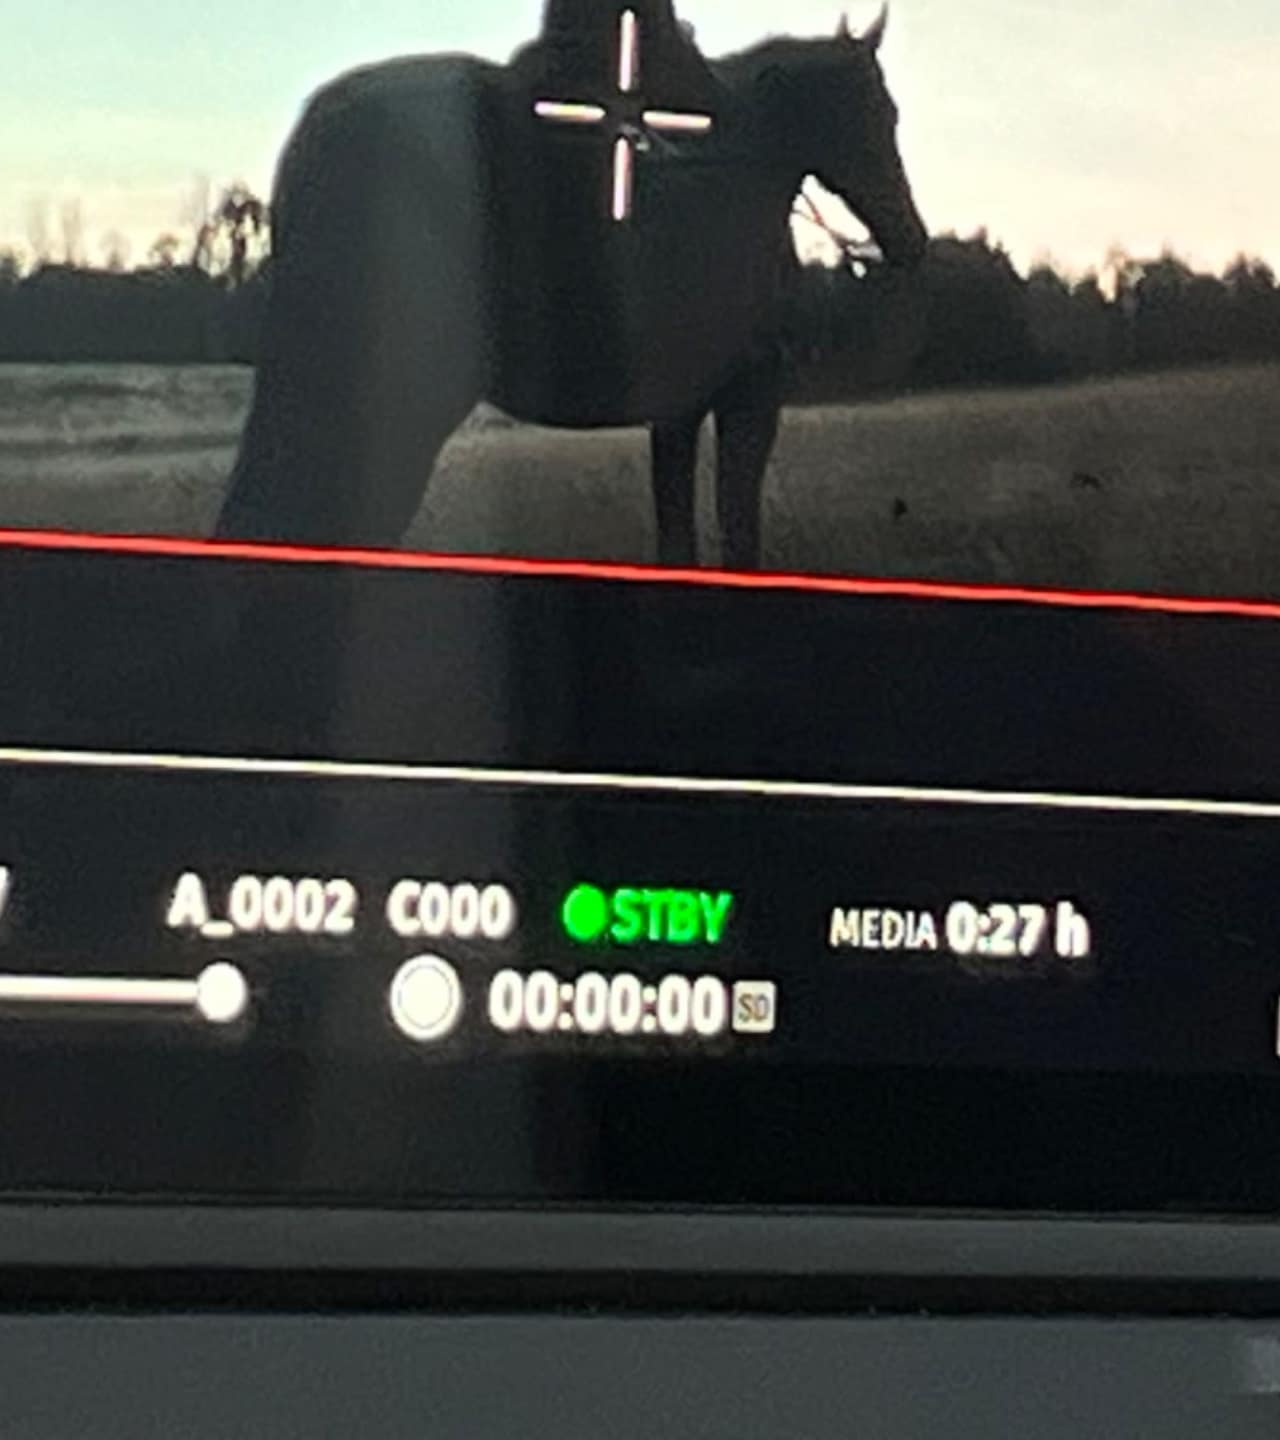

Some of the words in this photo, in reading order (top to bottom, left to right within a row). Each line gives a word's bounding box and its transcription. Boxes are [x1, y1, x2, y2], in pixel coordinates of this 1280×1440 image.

[166, 873, 356, 939] A_0002
[387, 878, 516, 940] C000
[609, 887, 732, 943] STBY
[829, 906, 938, 951] MEDIA
[945, 901, 1047, 957] 0:27
[1055, 901, 1091, 957] h
[487, 968, 727, 1036] 00:00:00
[737, 991, 770, 1023] SD
